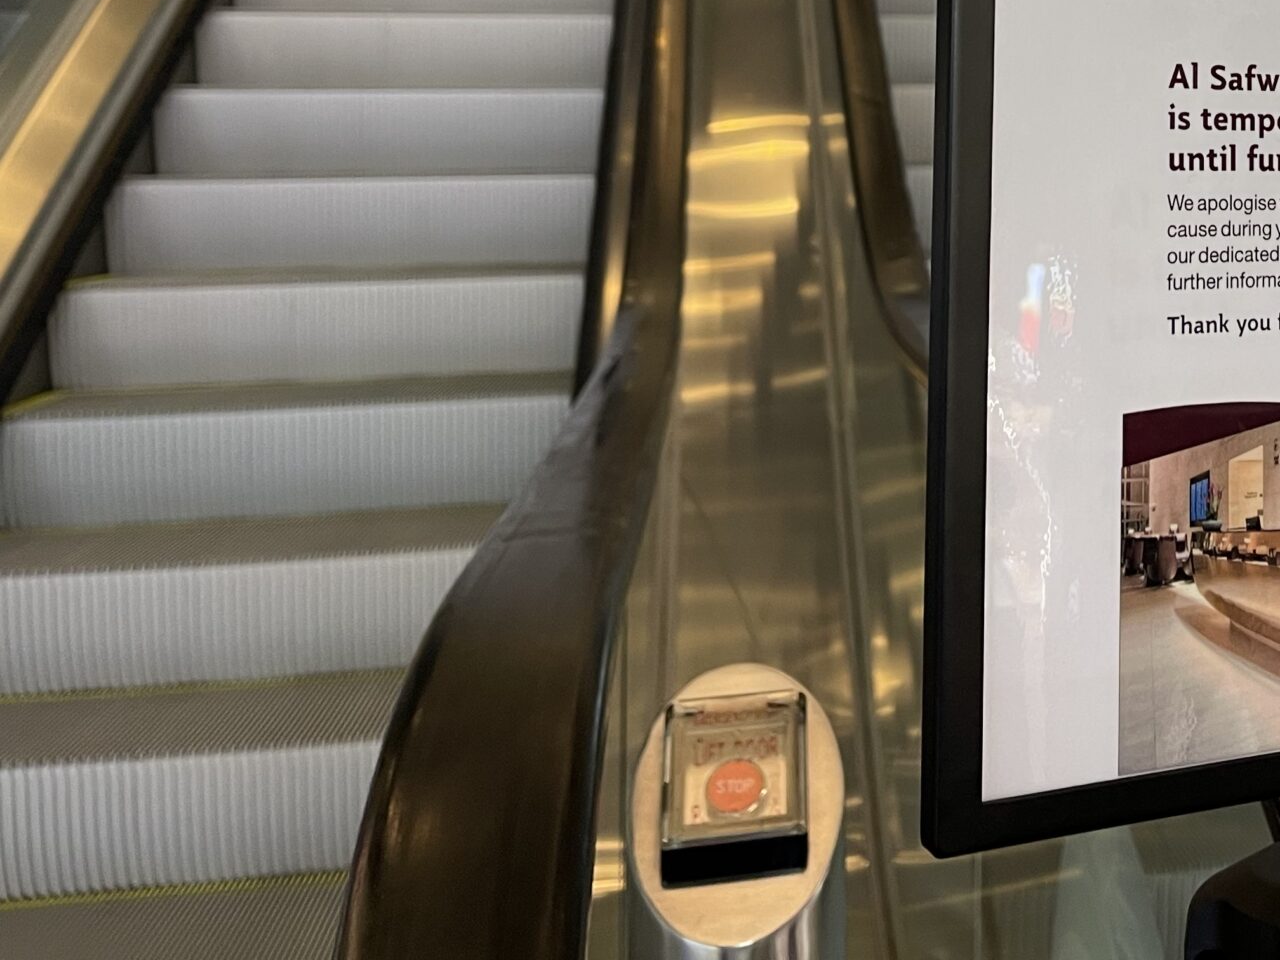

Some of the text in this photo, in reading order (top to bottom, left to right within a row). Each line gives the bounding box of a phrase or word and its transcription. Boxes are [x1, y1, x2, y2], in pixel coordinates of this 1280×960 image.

[1168, 62, 1198, 89] Al
[1168, 103, 1190, 130] is
[1169, 144, 1236, 171] until
[1167, 194, 1194, 211] We
[1197, 194, 1276, 215] apologise
[1167, 224, 1217, 238] cause
[1221, 220, 1272, 240] during
[1167, 251, 1195, 264] our
[1198, 245, 1279, 263] dedicated
[1167, 273, 1223, 291] further
[1167, 313, 1229, 335] Thank
[1237, 318, 1271, 337] you
[714, 778, 755, 794] STOP
